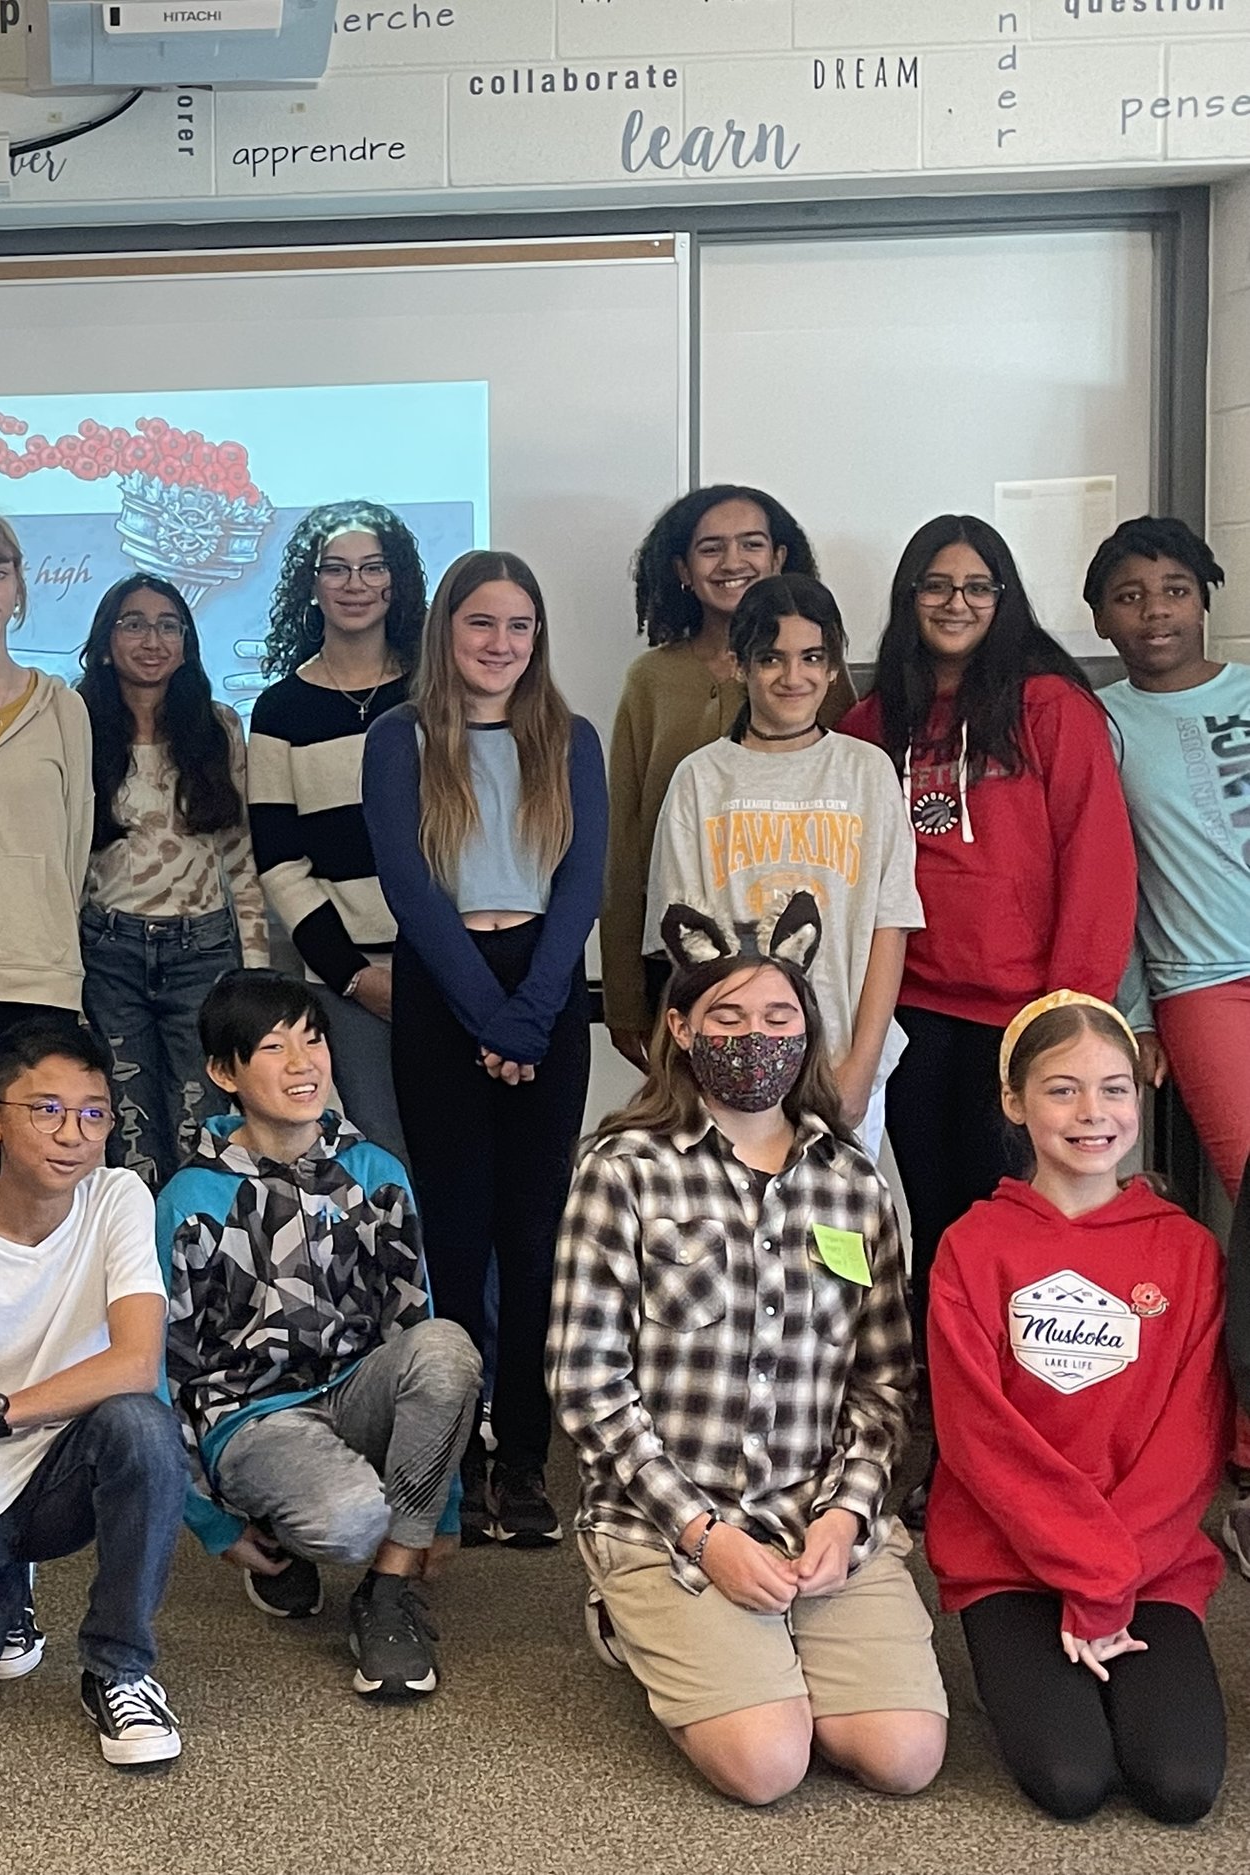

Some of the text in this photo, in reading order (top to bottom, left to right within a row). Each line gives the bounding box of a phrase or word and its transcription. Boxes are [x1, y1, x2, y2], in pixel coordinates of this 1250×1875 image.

[163, 10, 222, 22] HITACHI
[469, 64, 678, 96] collaborate
[813, 55, 920, 90] DREAM
[177, 95, 194, 156] orer
[1121, 94, 1250, 135] pense
[232, 138, 407, 178] apprendre
[621, 108, 801, 174] learn
[34, 554, 93, 601] high
[704, 810, 863, 891] HAWKINS
[1013, 1311, 1124, 1349] Muskoka
[1045, 1358, 1093, 1370] LAKE LIFE
